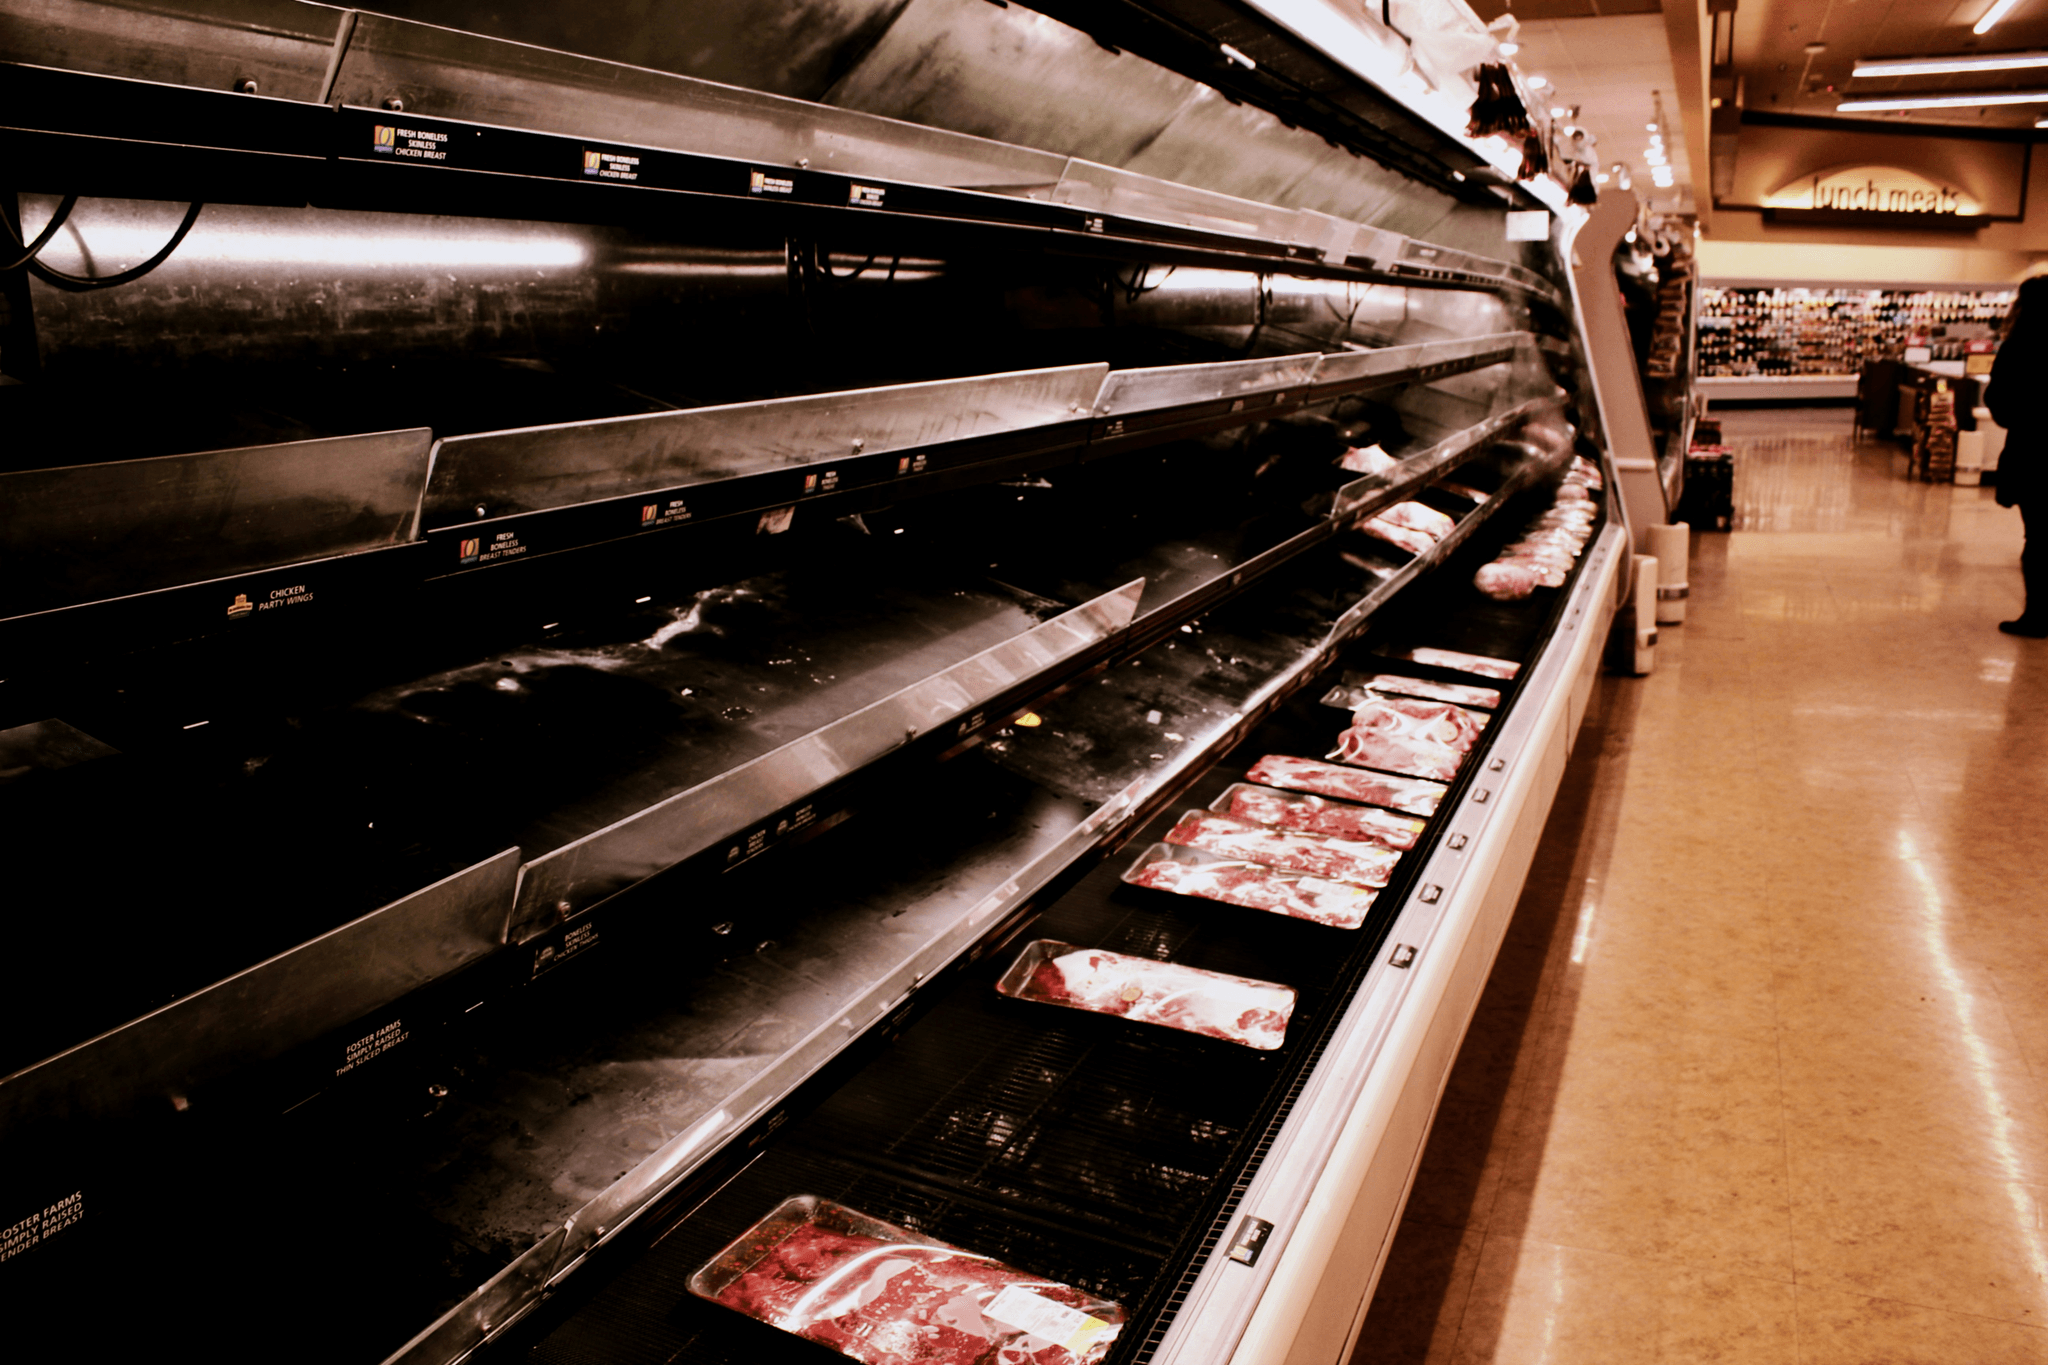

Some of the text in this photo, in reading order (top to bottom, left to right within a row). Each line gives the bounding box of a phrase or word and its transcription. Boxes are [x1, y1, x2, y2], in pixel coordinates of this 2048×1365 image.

[397, 128, 448, 142] FRESH BONELESS
[408, 139, 436, 150] SKINLESS
[395, 147, 447, 160] CHICKEN BREAST
[601, 153, 616, 162] FRESH
[599, 169, 620, 179] CHICKEN
[1813, 175, 1958, 213] lunch meats
[490, 539, 519, 551] BONELESS
[496, 532, 515, 542] FRESH
[479, 550, 501, 562] BREAST
[502, 545, 527, 558] TENDERS
[270, 584, 305, 600] CHICKEN
[258, 598, 285, 612] PARTY
[286, 592, 314, 606] WINGS
[346, 1018, 401, 1055] FOSTER FARMS
[335, 1031, 410, 1077] THIN SLICED BREAST
[346, 1028, 401, 1064] SIMPLY RAISED
[43, 1189, 82, 1219] FARMS
[42, 1202, 82, 1230] RAISED
[42, 1209, 85, 1240] BREAST
